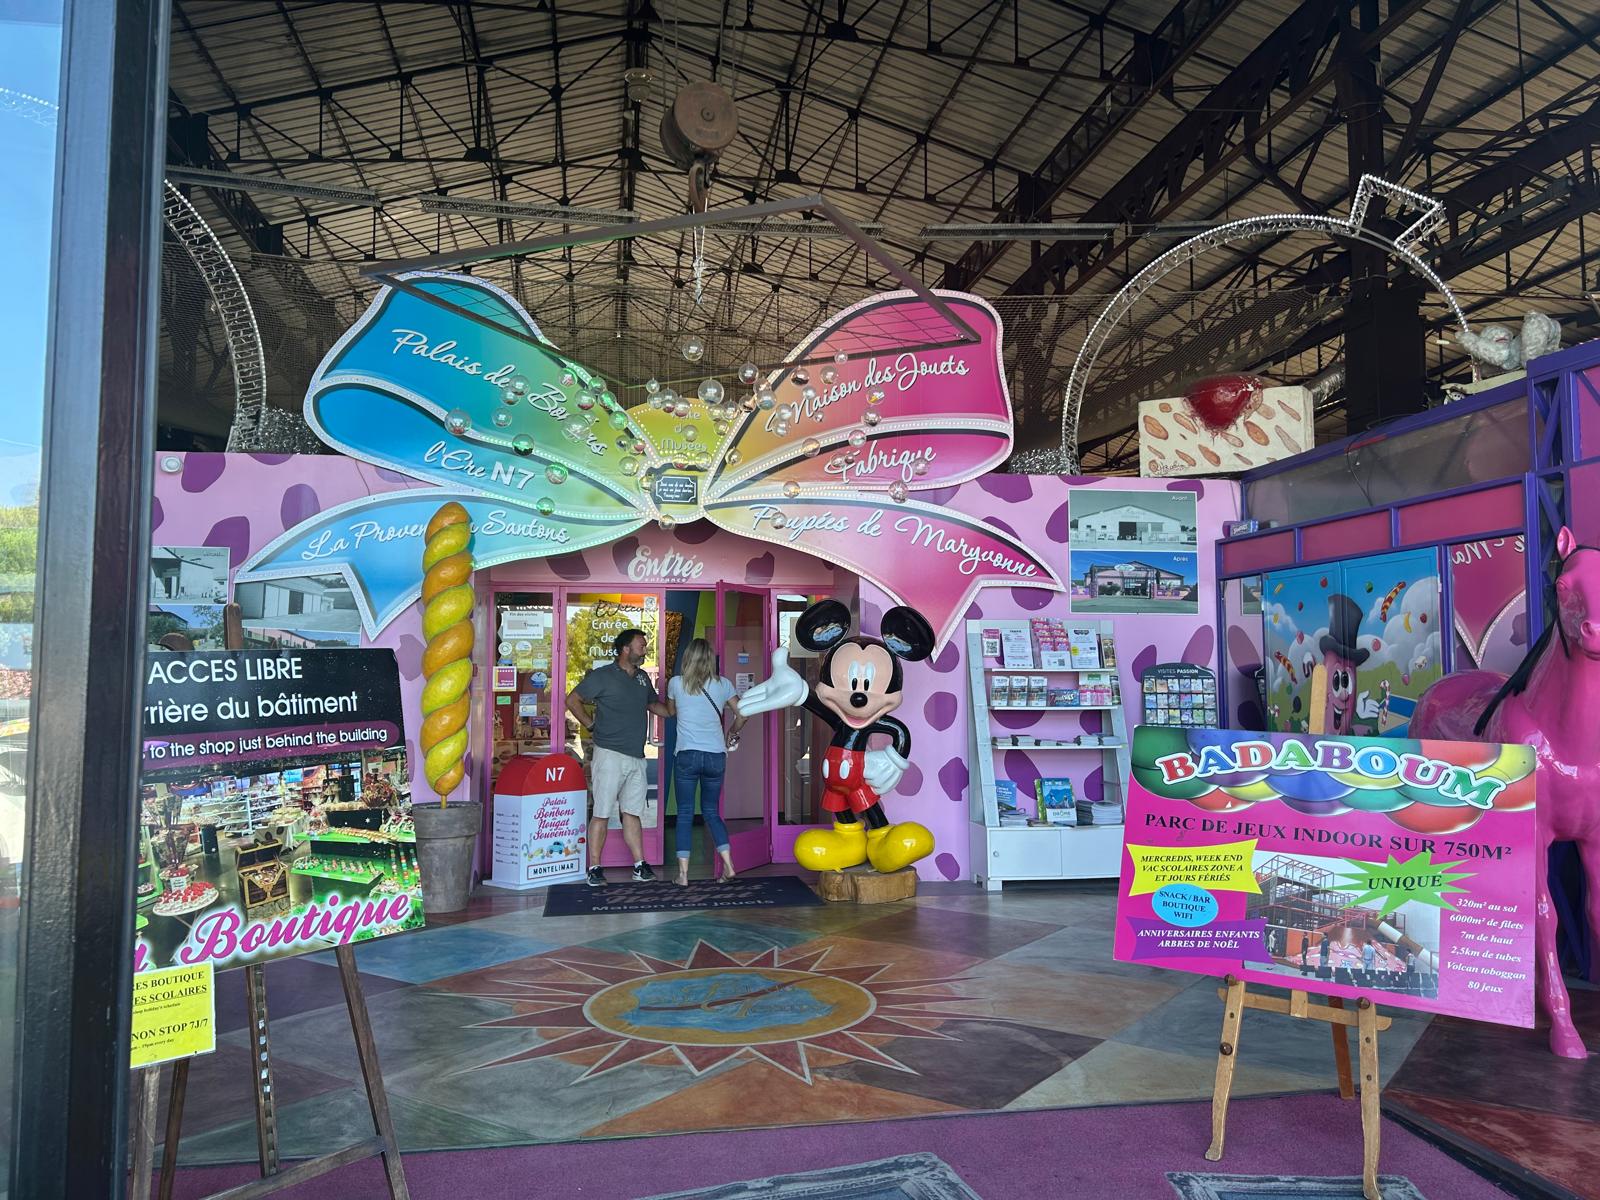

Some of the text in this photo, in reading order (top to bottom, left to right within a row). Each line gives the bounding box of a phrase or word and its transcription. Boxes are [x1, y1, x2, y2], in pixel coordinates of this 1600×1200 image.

[392, 329, 482, 375] Palais
[483, 364, 516, 388] de
[864, 358, 896, 388] des
[895, 352, 969, 391] Jouets
[824, 440, 937, 483] Fabrique
[491, 461, 535, 490] N7
[301, 529, 350, 560] La
[349, 521, 428, 549] Proven
[481, 510, 570, 544] Santons
[749, 503, 1037, 577] Pupées de Maryvonne
[628, 545, 704, 582] Entrée
[592, 619, 628, 629] Entrée
[601, 632, 617, 643] de
[589, 646, 618, 657] Mus
[148, 657, 302, 685] ACCES LIBRE
[217, 697, 250, 720] du
[258, 690, 358, 717] bâtiment
[150, 744, 166, 759] to
[169, 741, 195, 757] the
[200, 739, 235, 757] shop
[238, 735, 262, 754] just
[265, 731, 313, 749] behind
[316, 729, 336, 745] the
[339, 726, 388, 743] building
[546, 767, 565, 782] N7
[1157, 740, 1504, 808] BADABOUM
[542, 797, 567, 807] Palais
[534, 807, 575, 819] Bonbons
[538, 818, 570, 829] Nougat
[533, 828, 576, 840] Souvenirs
[1144, 813, 1512, 860] PARC DE JEUX INDOOR SUR 750M²
[1141, 855, 1194, 863] MERCREDIS,
[1222, 854, 1243, 862] END
[533, 863, 574, 875] MONTELIMAR
[1168, 874, 1196, 882] JOURS
[1198, 873, 1231, 881] FÉRIÉS
[1368, 874, 1442, 892] UNIQUE
[1159, 891, 1188, 901] SNACK
[1193, 896, 1211, 904] BAR
[1456, 898, 1518, 913] 320m² au sol
[1162, 901, 1206, 912] BOUTIQUE
[1174, 911, 1193, 920] WIFI
[1449, 914, 1524, 930] 6000m² de filets
[179, 894, 410, 963] Boutique
[1137, 929, 1260, 939] ANNIVERSAIRES ENFANTS
[1158, 939, 1240, 949] ARBRES DE NOËL
[1460, 931, 1514, 945] 7m de haut
[1451, 946, 1522, 962] 2,5km de tubes
[1447, 961, 1527, 980] Volcan toboggan
[151, 971, 205, 988] BOUTIQUE
[1467, 980, 1504, 993] 80 jeux
[149, 984, 207, 1002] SCOLAIRES
[131, 1018, 208, 1041] NON STOP 7J/7
